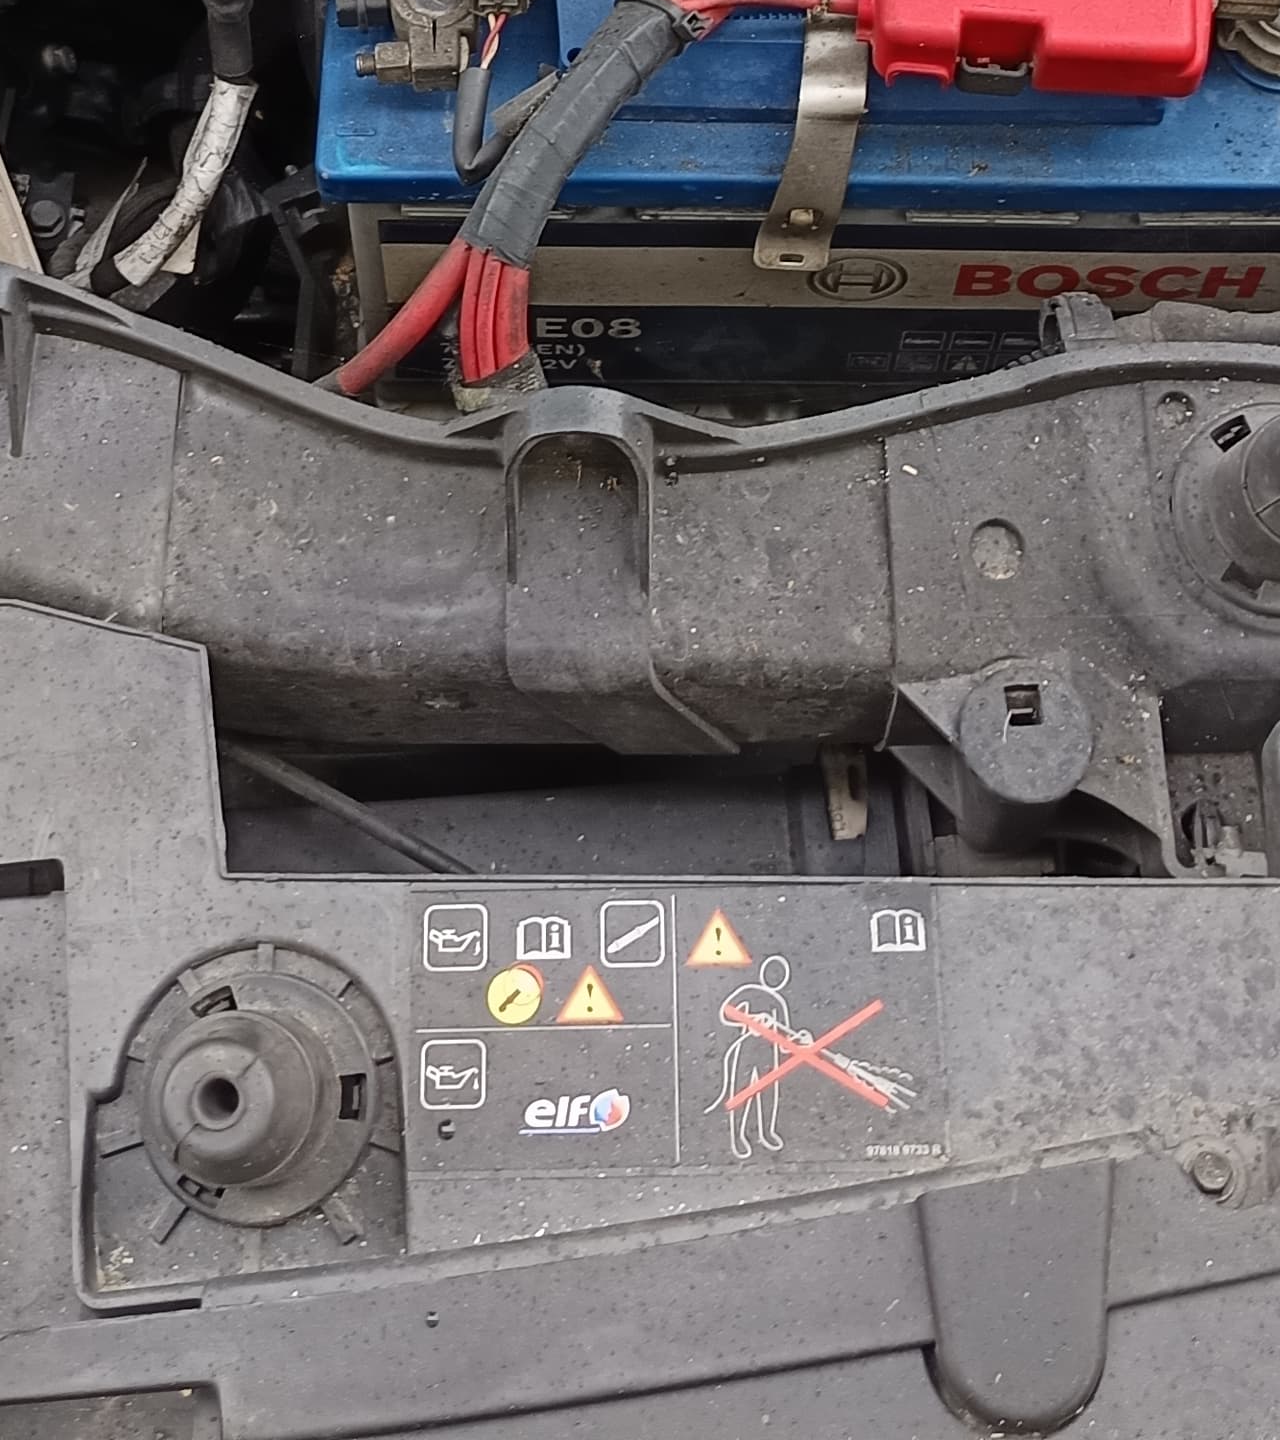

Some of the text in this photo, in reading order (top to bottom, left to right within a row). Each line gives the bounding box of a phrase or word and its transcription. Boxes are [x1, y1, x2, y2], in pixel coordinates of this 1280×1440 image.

[952, 263, 1267, 299] BOSCH
[535, 317, 643, 339] E08
[535, 343, 586, 357] EN)
[541, 359, 578, 370] 2V
[523, 1094, 592, 1128] elf
